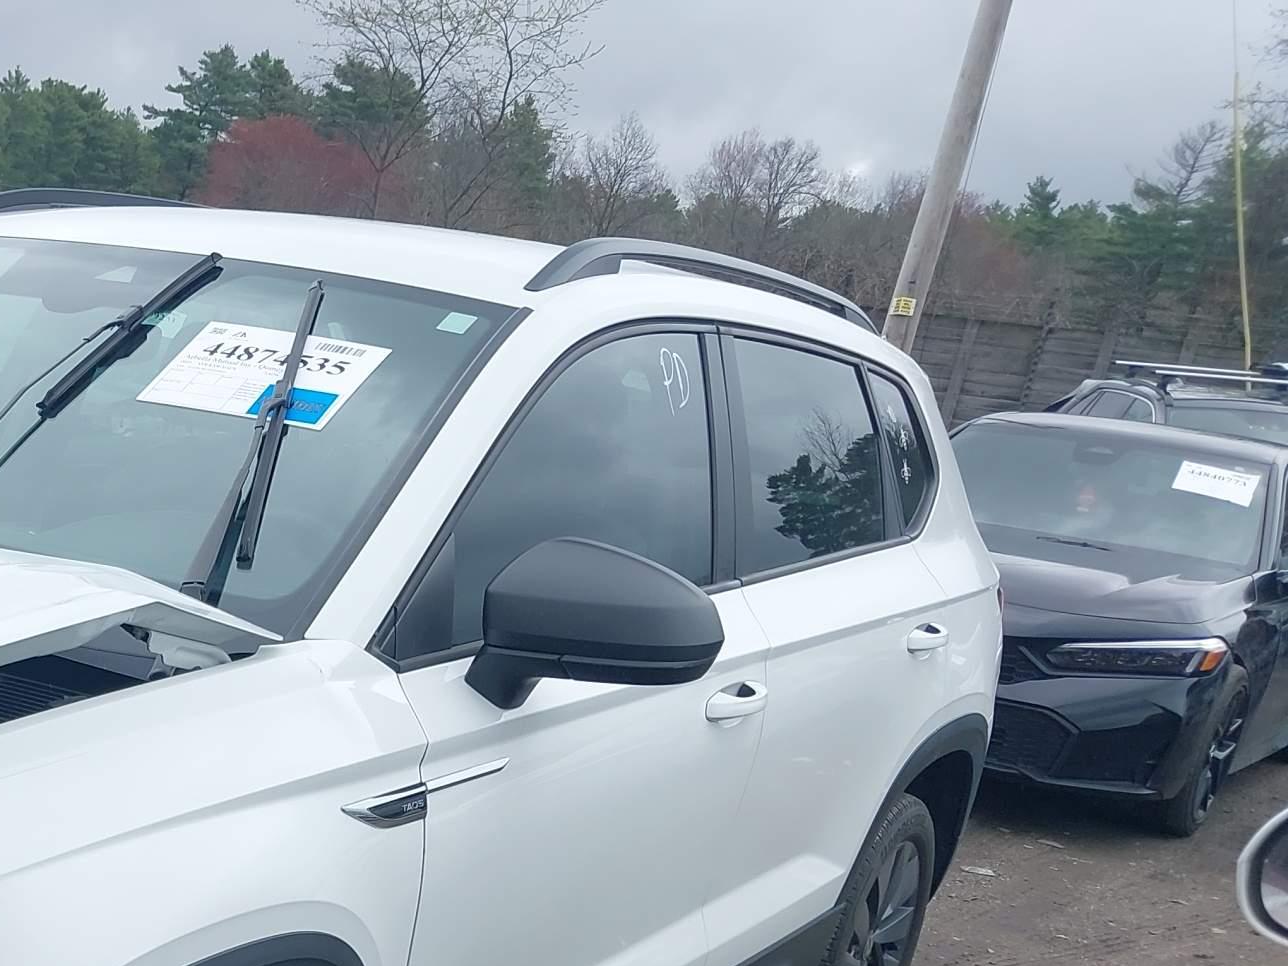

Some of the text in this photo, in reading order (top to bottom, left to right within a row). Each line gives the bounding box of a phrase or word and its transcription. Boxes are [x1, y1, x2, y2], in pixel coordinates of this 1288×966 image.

[202, 342, 352, 376] 44874535
[660, 346, 690, 417] PD
[401, 799, 424, 813] TAOS
